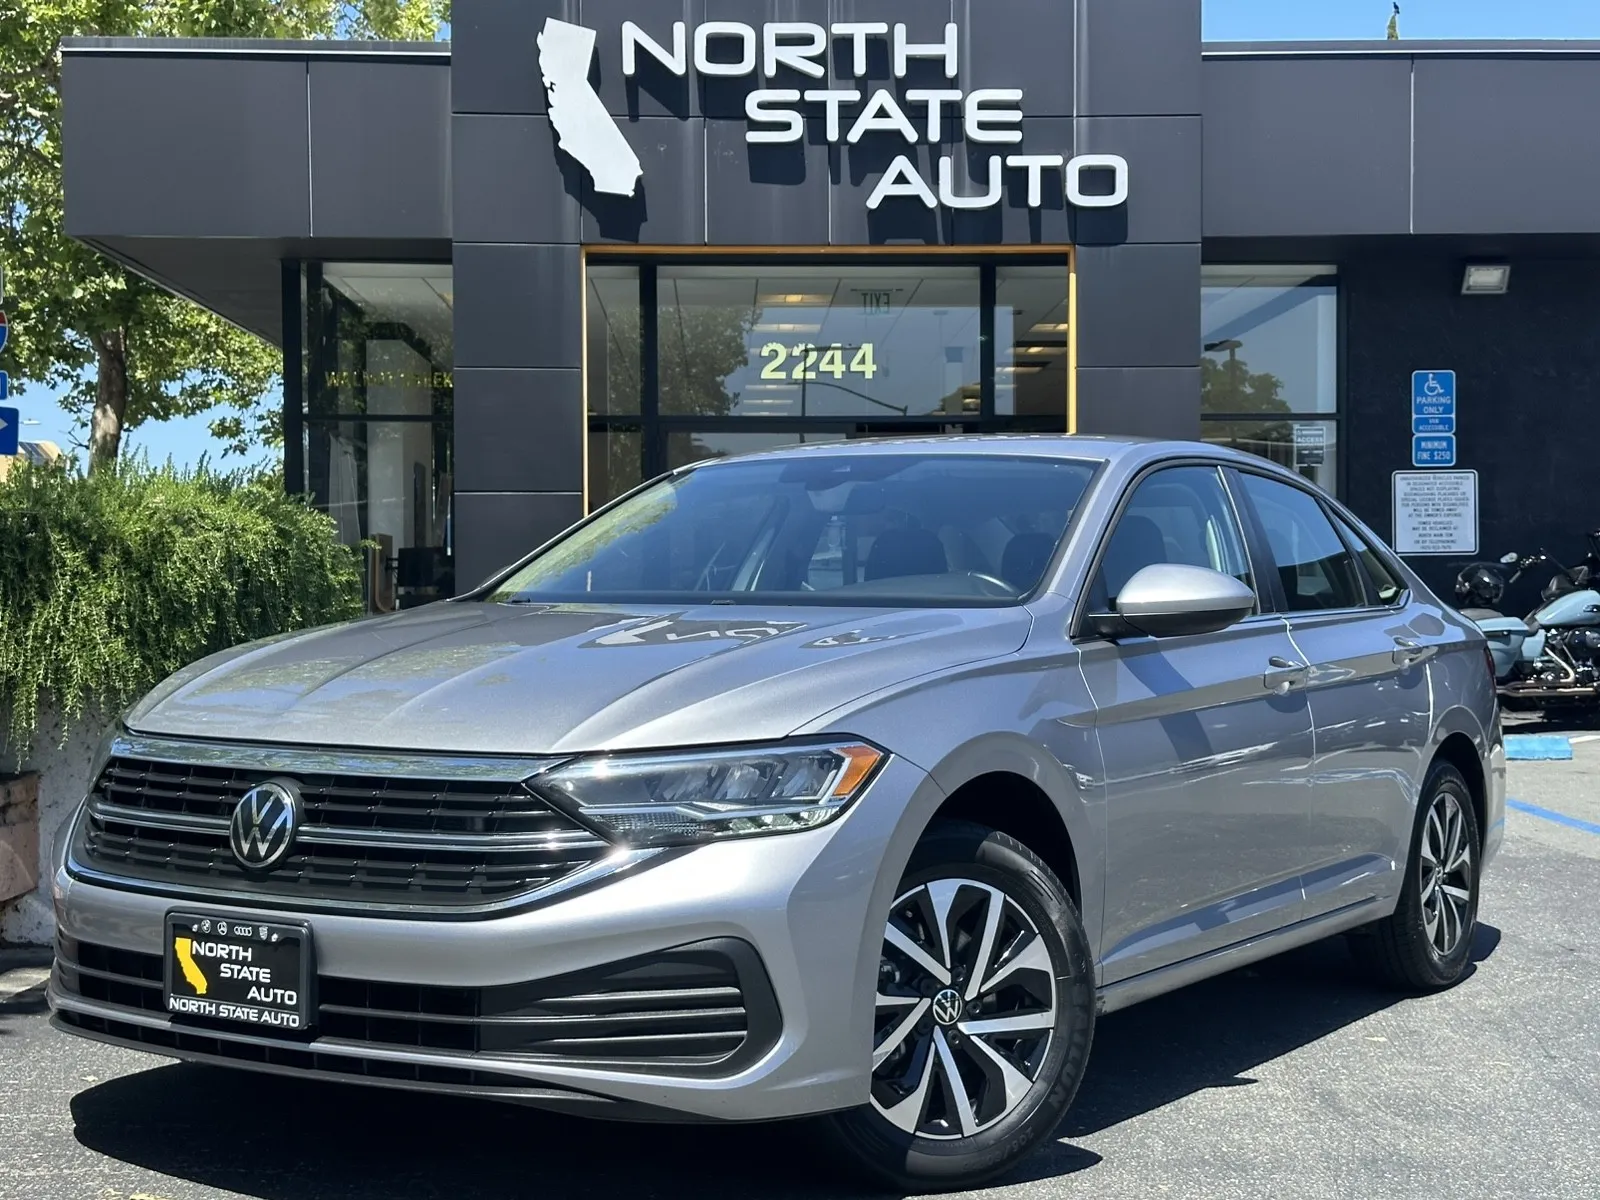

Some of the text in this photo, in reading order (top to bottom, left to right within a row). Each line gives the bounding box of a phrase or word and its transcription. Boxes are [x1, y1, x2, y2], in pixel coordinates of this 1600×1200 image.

[622, 21, 958, 78] NORTH
[745, 89, 1023, 143] STATE
[866, 154, 1128, 209] AUTO
[760, 342, 877, 379] 2244
[1417, 451, 1450, 460] FINE $250
[1421, 441, 1447, 449] MINIMUM
[192, 941, 252, 962] NORTH
[220, 963, 271, 983] STATE
[247, 986, 297, 1005] AUTO
[169, 997, 299, 1027] NORTH STATE AUTO
